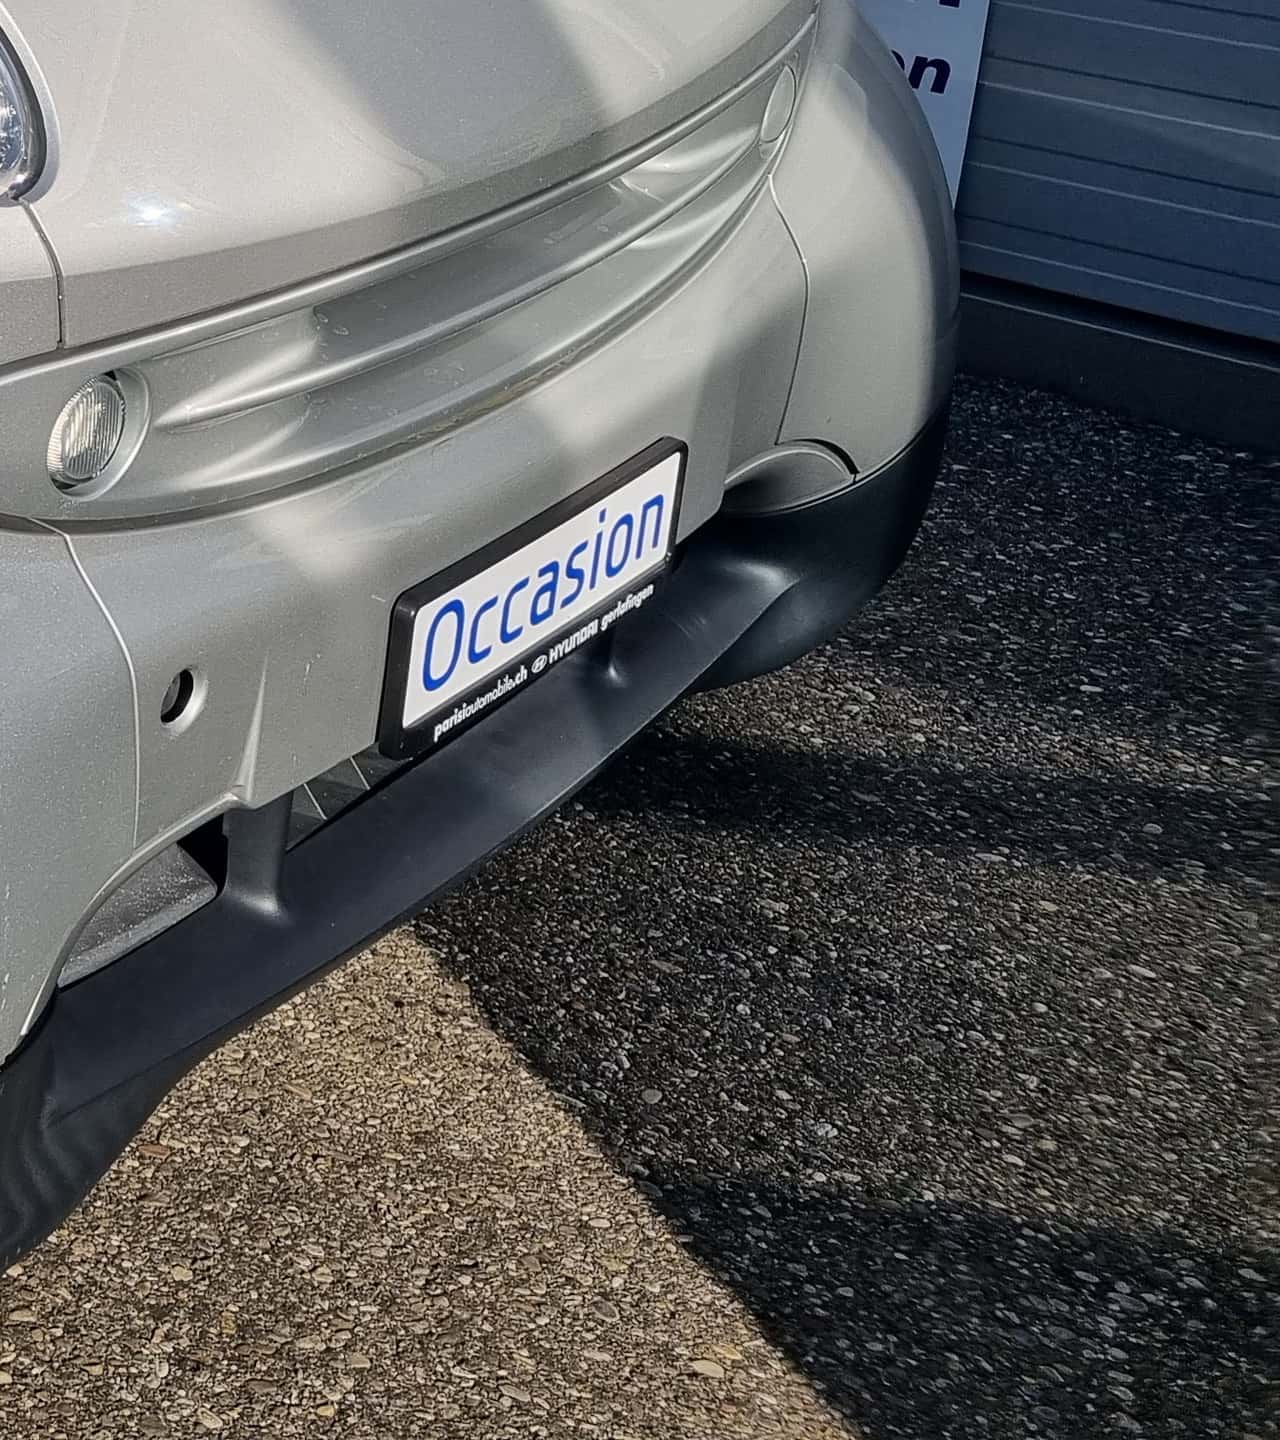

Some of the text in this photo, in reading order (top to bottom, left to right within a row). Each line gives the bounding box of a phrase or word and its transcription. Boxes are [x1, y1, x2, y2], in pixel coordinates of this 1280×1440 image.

[422, 493, 665, 692] Occasion
[433, 665, 528, 743] parisiautomobile.ch
[548, 618, 599, 665] HYUNDAI
